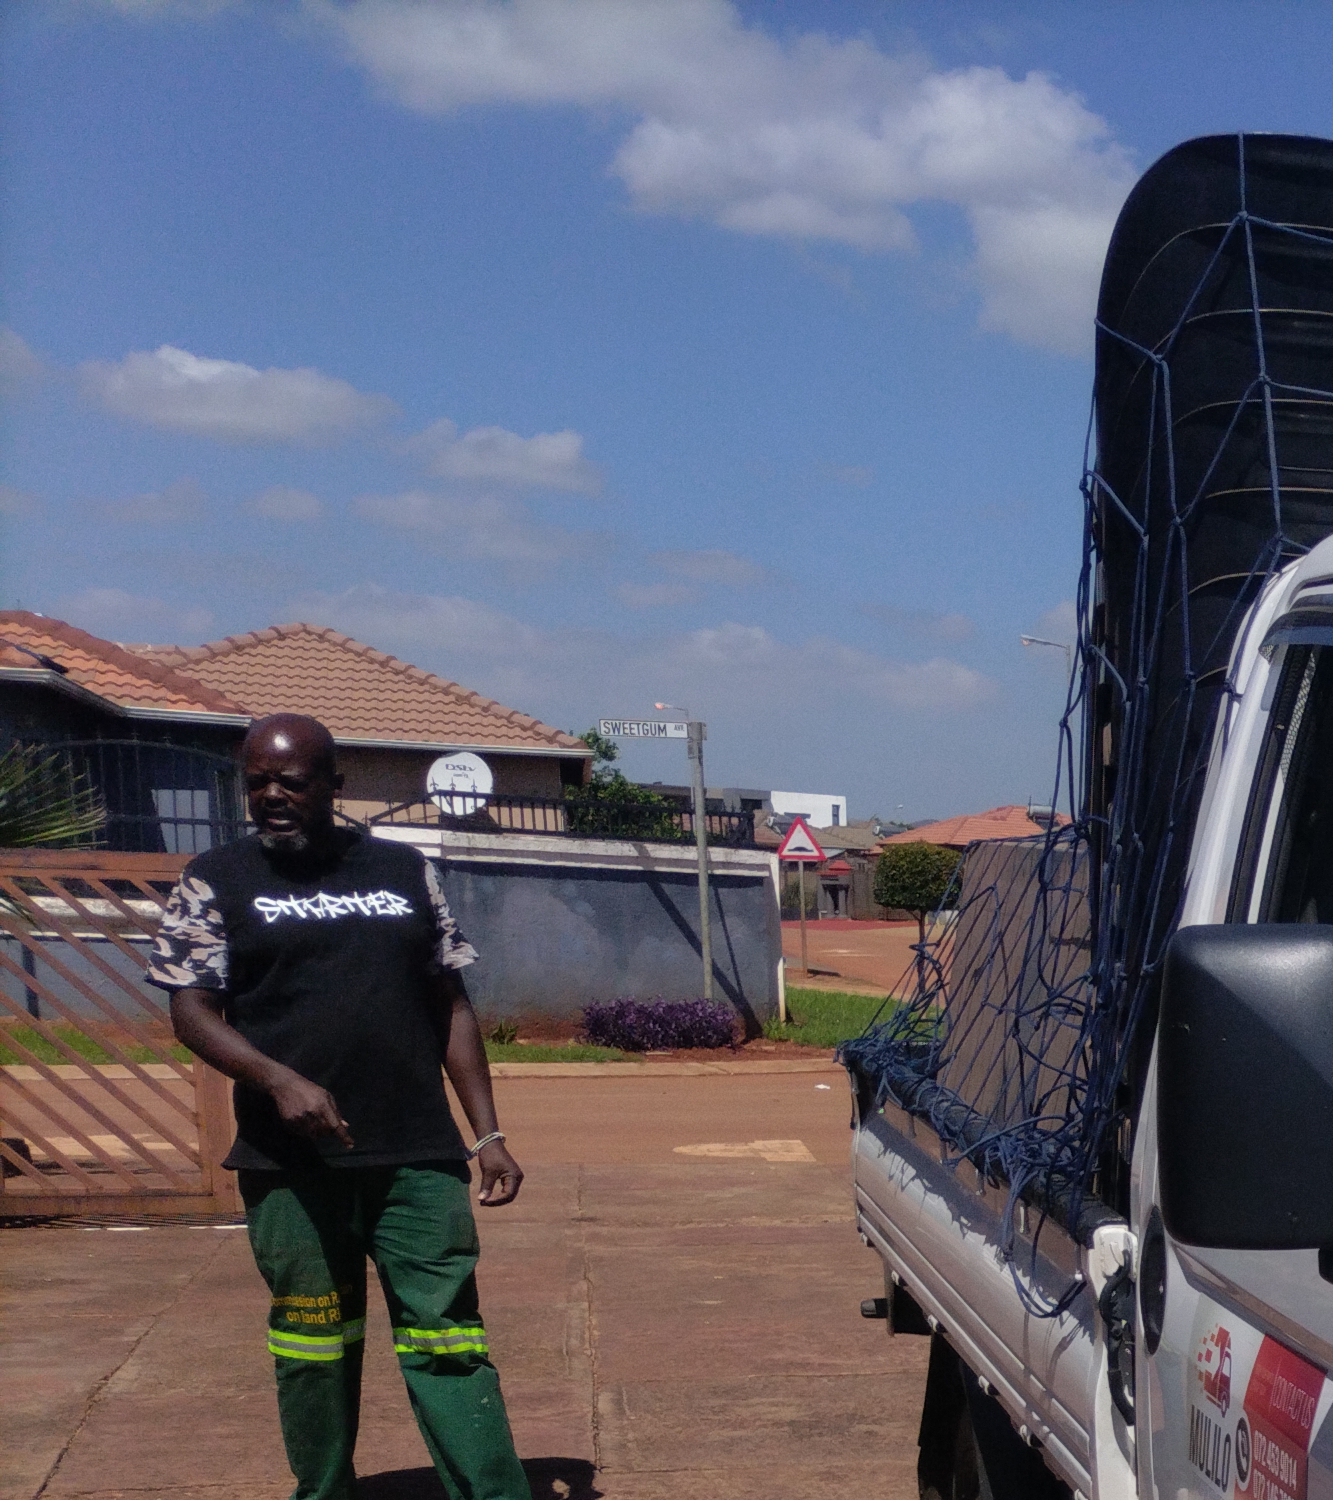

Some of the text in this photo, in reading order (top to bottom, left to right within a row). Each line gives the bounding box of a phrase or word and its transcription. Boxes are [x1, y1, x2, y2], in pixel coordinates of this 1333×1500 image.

[602, 721, 668, 737] SWEETGUM
[1188, 1404, 1232, 1493] MULILO
[1253, 1430, 1297, 1491] 072 453 9014
